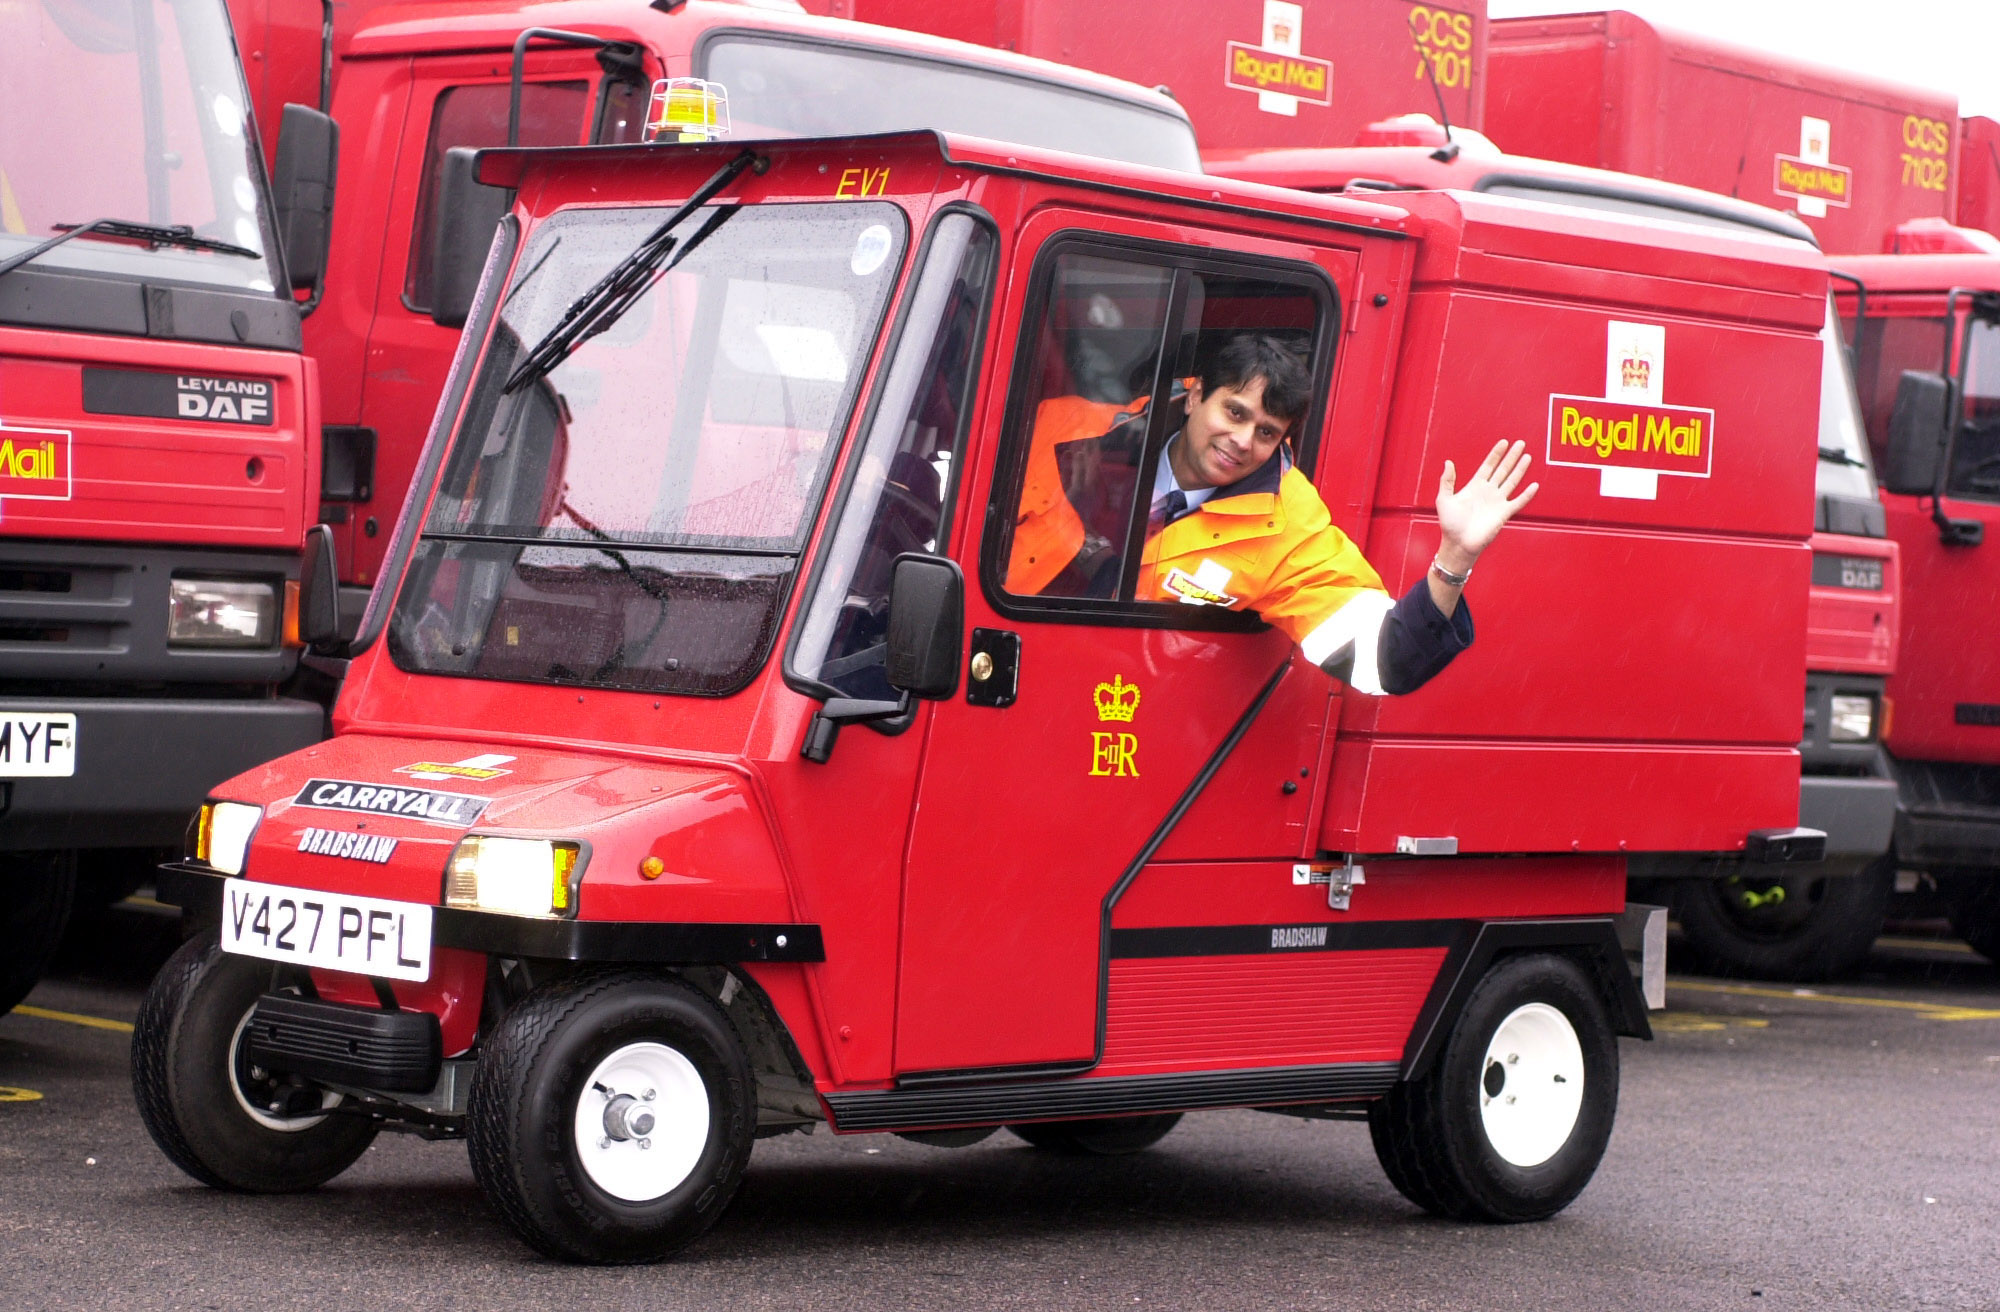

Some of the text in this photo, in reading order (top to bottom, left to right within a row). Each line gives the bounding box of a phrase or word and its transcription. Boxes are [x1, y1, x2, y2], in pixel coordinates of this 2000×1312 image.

[1408, 5, 1473, 52] CCS
[1233, 50, 1326, 92] Royal Mail
[1413, 43, 1473, 91] 7101
[1903, 114, 1949, 155] CCS
[835, 168, 891, 201] EV1
[1901, 153, 1948, 192] 7102
[177, 377, 267, 396] LEYLAND
[178, 392, 267, 421] DAF
[1560, 406, 1702, 458] Royal Mail
[311, 783, 465, 820] CARRYALL
[297, 827, 398, 863] BRADSHAW
[231, 890, 422, 969] V427 PFL
[1271, 927, 1328, 949] BRADSHAW
